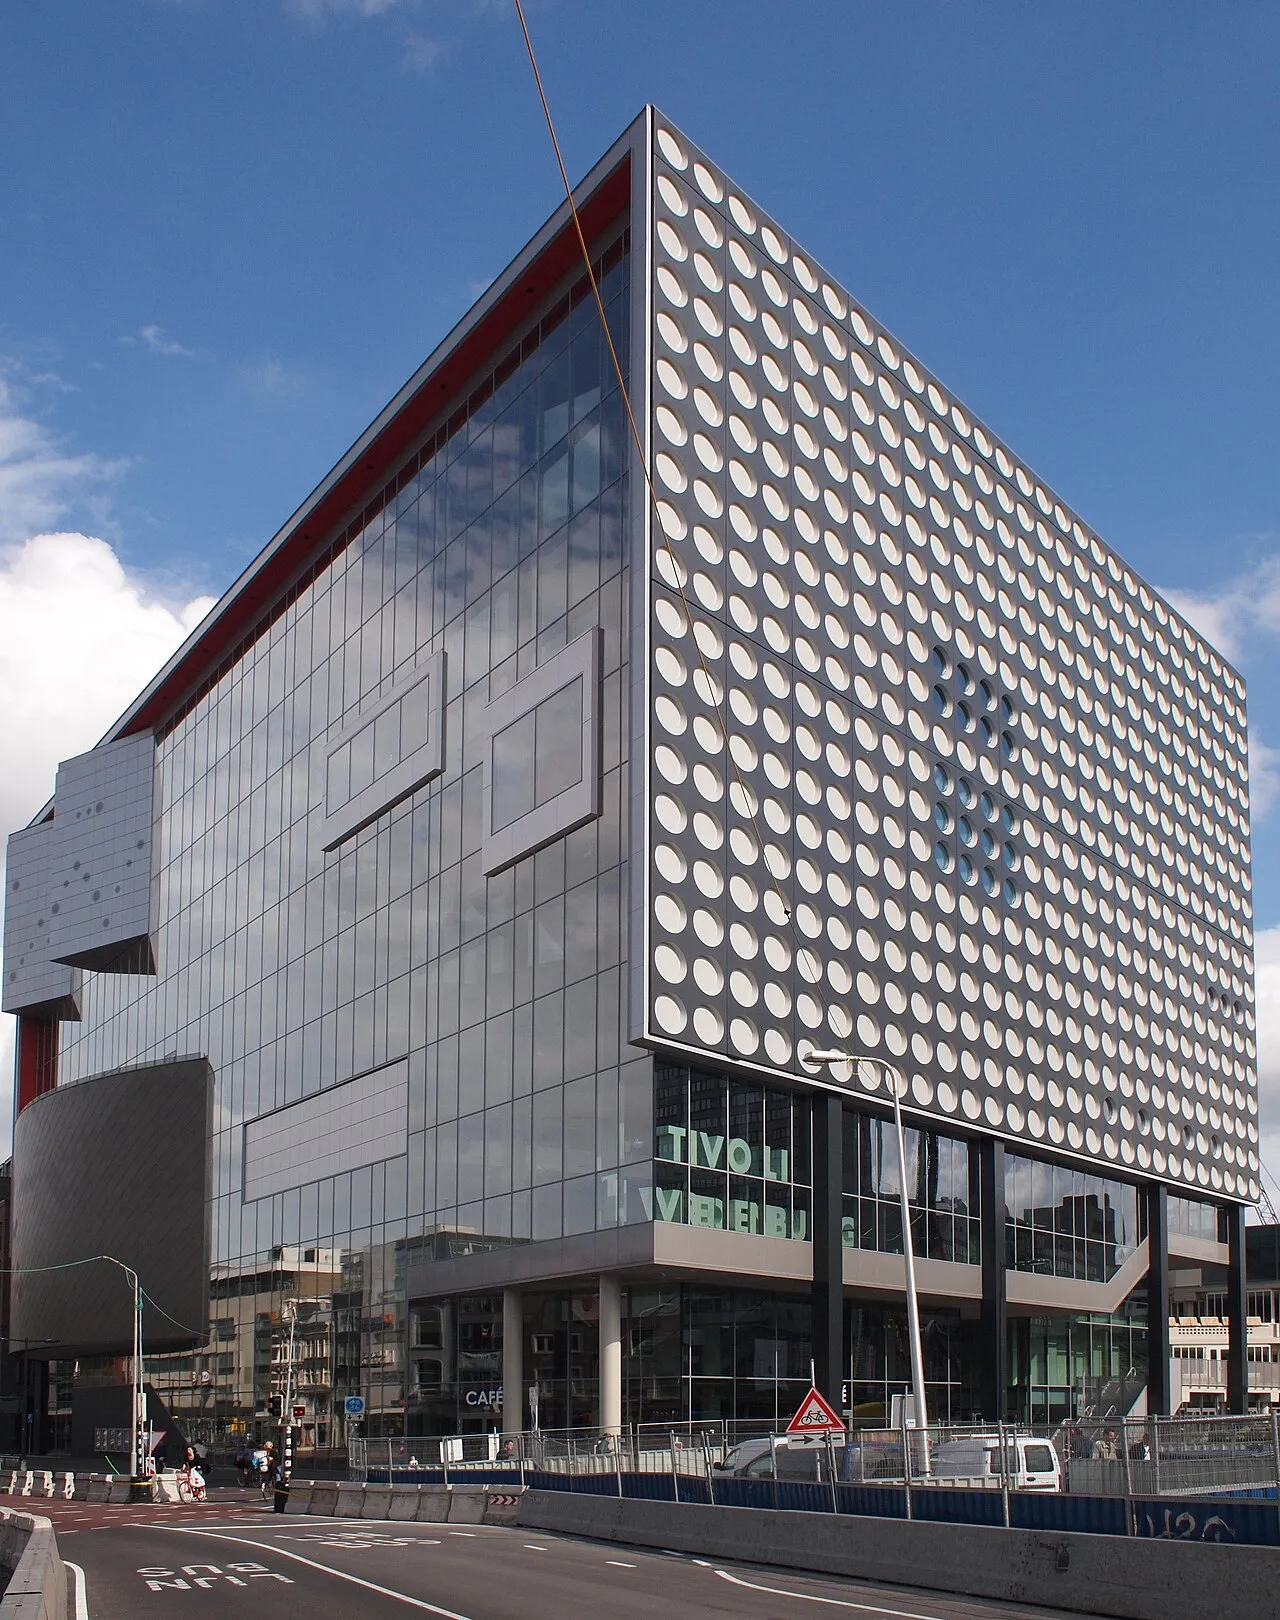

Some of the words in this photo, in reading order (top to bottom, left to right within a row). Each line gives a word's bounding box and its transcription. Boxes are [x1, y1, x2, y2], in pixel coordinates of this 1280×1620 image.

[659, 1124, 788, 1182] TIVOLI
[465, 1386, 504, 1406] CAFÉ
[318, 1538, 441, 1549] BUS
[136, 1562, 270, 1578] BUS
[145, 1573, 296, 1591] LIJN
